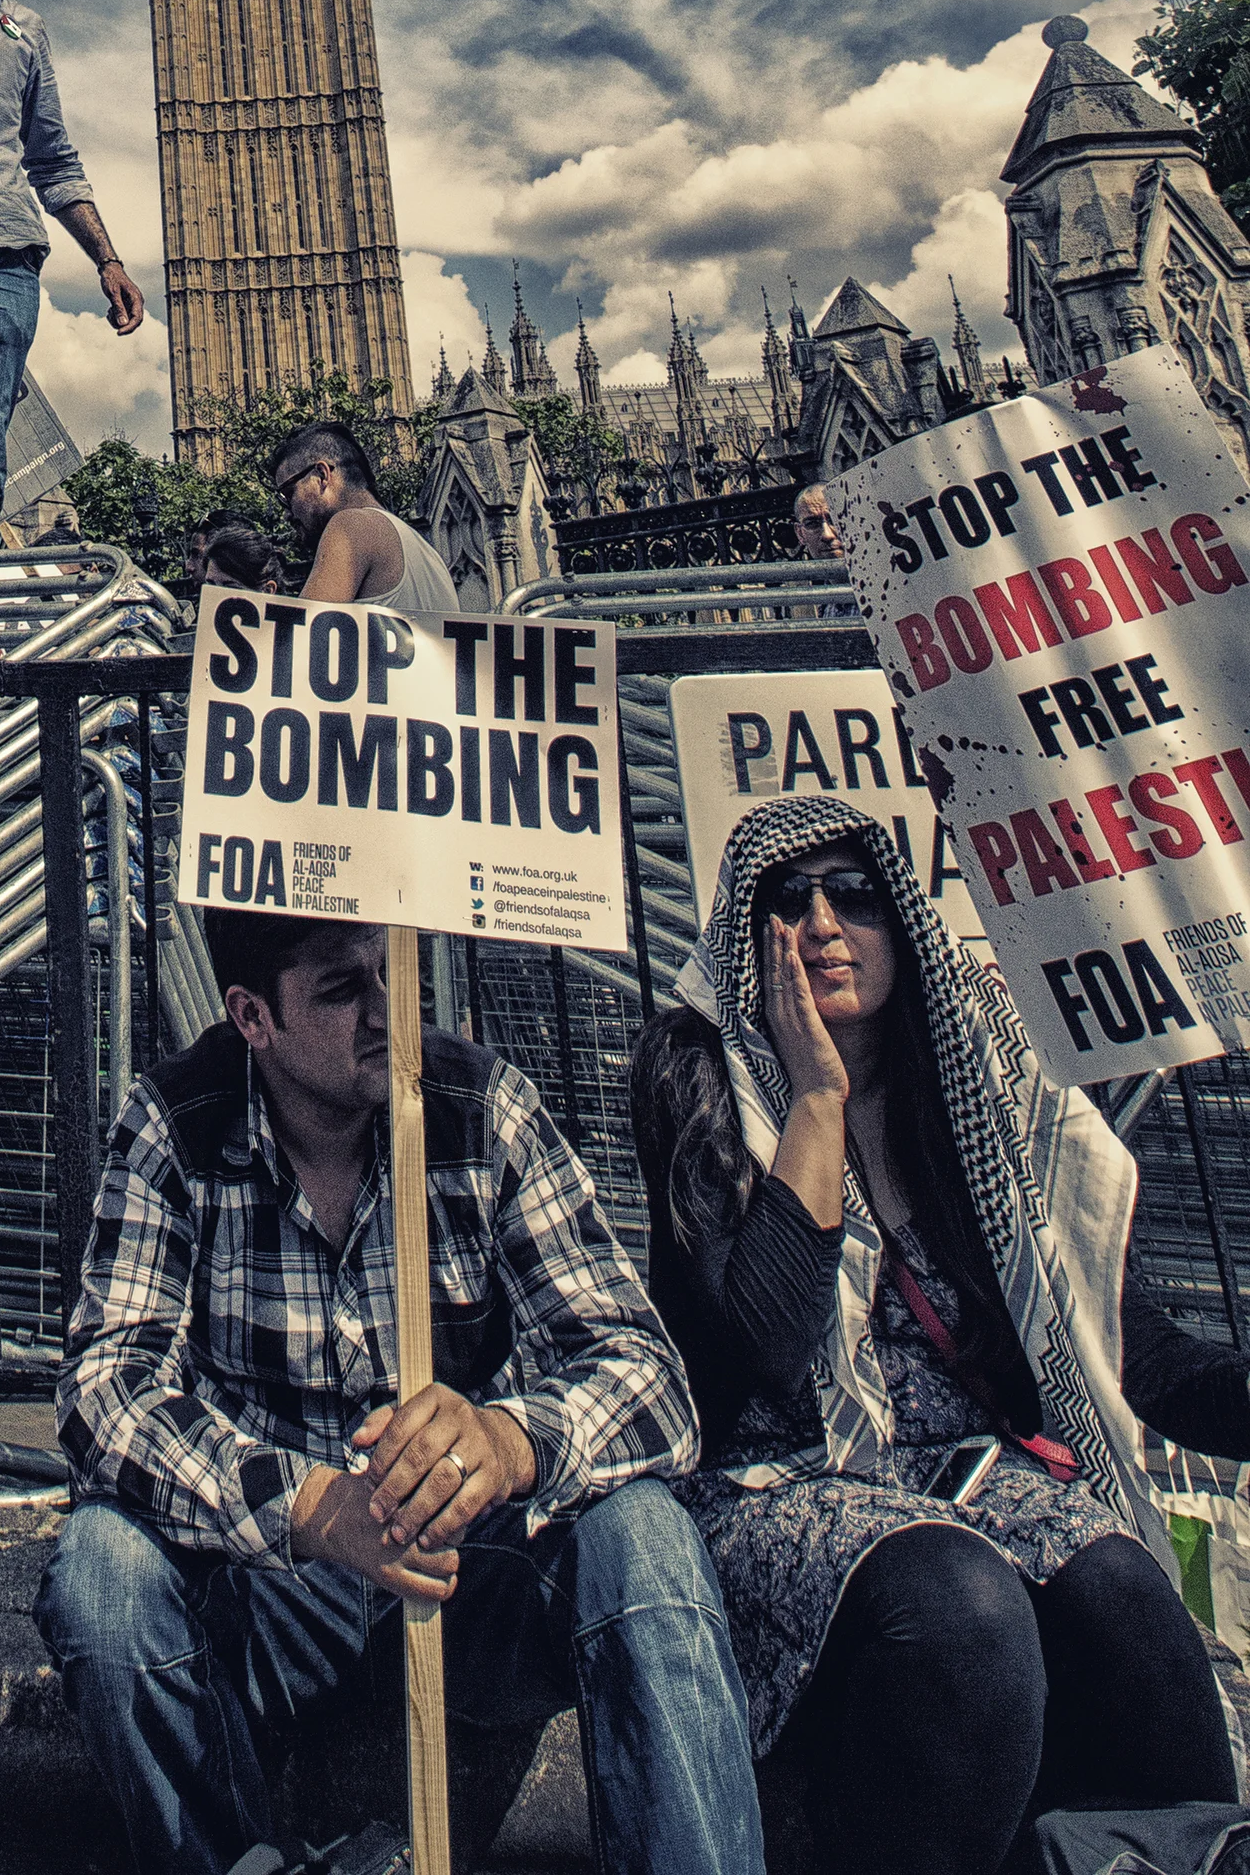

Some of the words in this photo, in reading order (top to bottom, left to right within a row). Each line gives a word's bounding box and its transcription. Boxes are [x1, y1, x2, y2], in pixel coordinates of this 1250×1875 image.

[881, 469, 1020, 574] STOP
[1025, 425, 1155, 518] THE
[895, 511, 1248, 692] BOMBING
[208, 597, 415, 705] STOP
[443, 620, 599, 726] THE
[1017, 653, 1185, 758] FREE
[203, 700, 602, 836] BOMBING
[293, 842, 337, 862] FRIENDS
[338, 845, 352, 862] OF
[196, 832, 287, 908] FOA
[292, 859, 337, 879] AL-AQSA
[292, 876, 325, 894] PEACE
[492, 863, 578, 883] www.foa.org.uk
[492, 881, 607, 904] /foapeaceinpalestine
[493, 898, 591, 922] @friendsofalaqsa
[493, 917, 582, 940] /friendsofalaqsa
[1163, 918, 1230, 953] FRIENDS
[1226, 912, 1248, 937] OF
[1176, 942, 1243, 976] AL-AQSA
[1040, 939, 1198, 1053] FOA
[1185, 969, 1238, 1000] PEACE
[1197, 1000, 1217, 1024] IN
